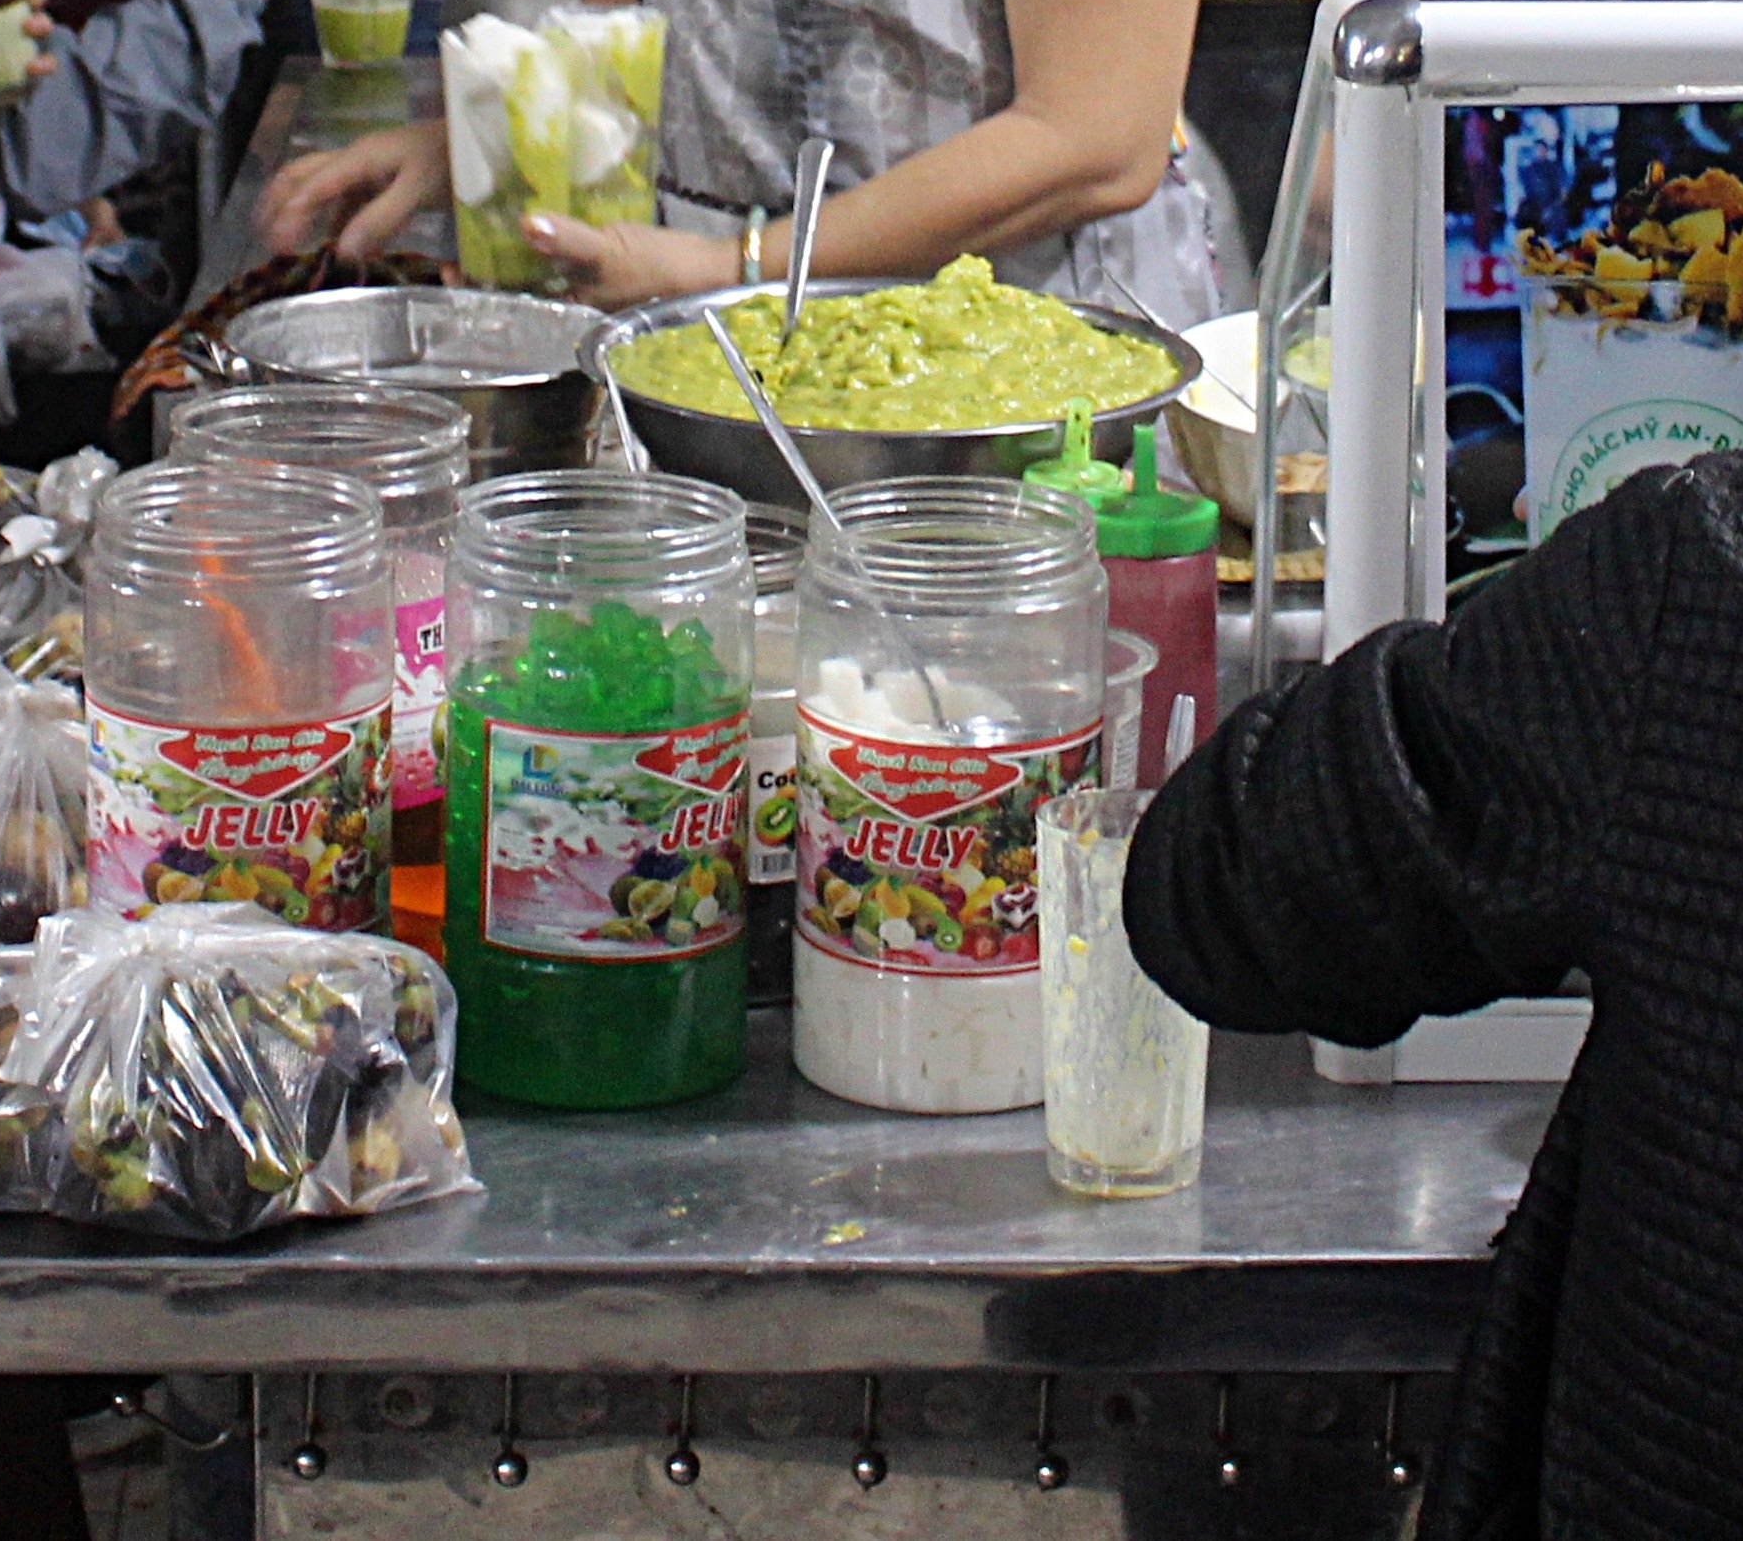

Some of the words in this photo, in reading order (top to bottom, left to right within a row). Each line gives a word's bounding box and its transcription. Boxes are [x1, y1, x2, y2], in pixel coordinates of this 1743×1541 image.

[1666, 422, 1703, 441] AN
[183, 796, 320, 851] JELLY
[844, 816, 980, 872] JELLY
